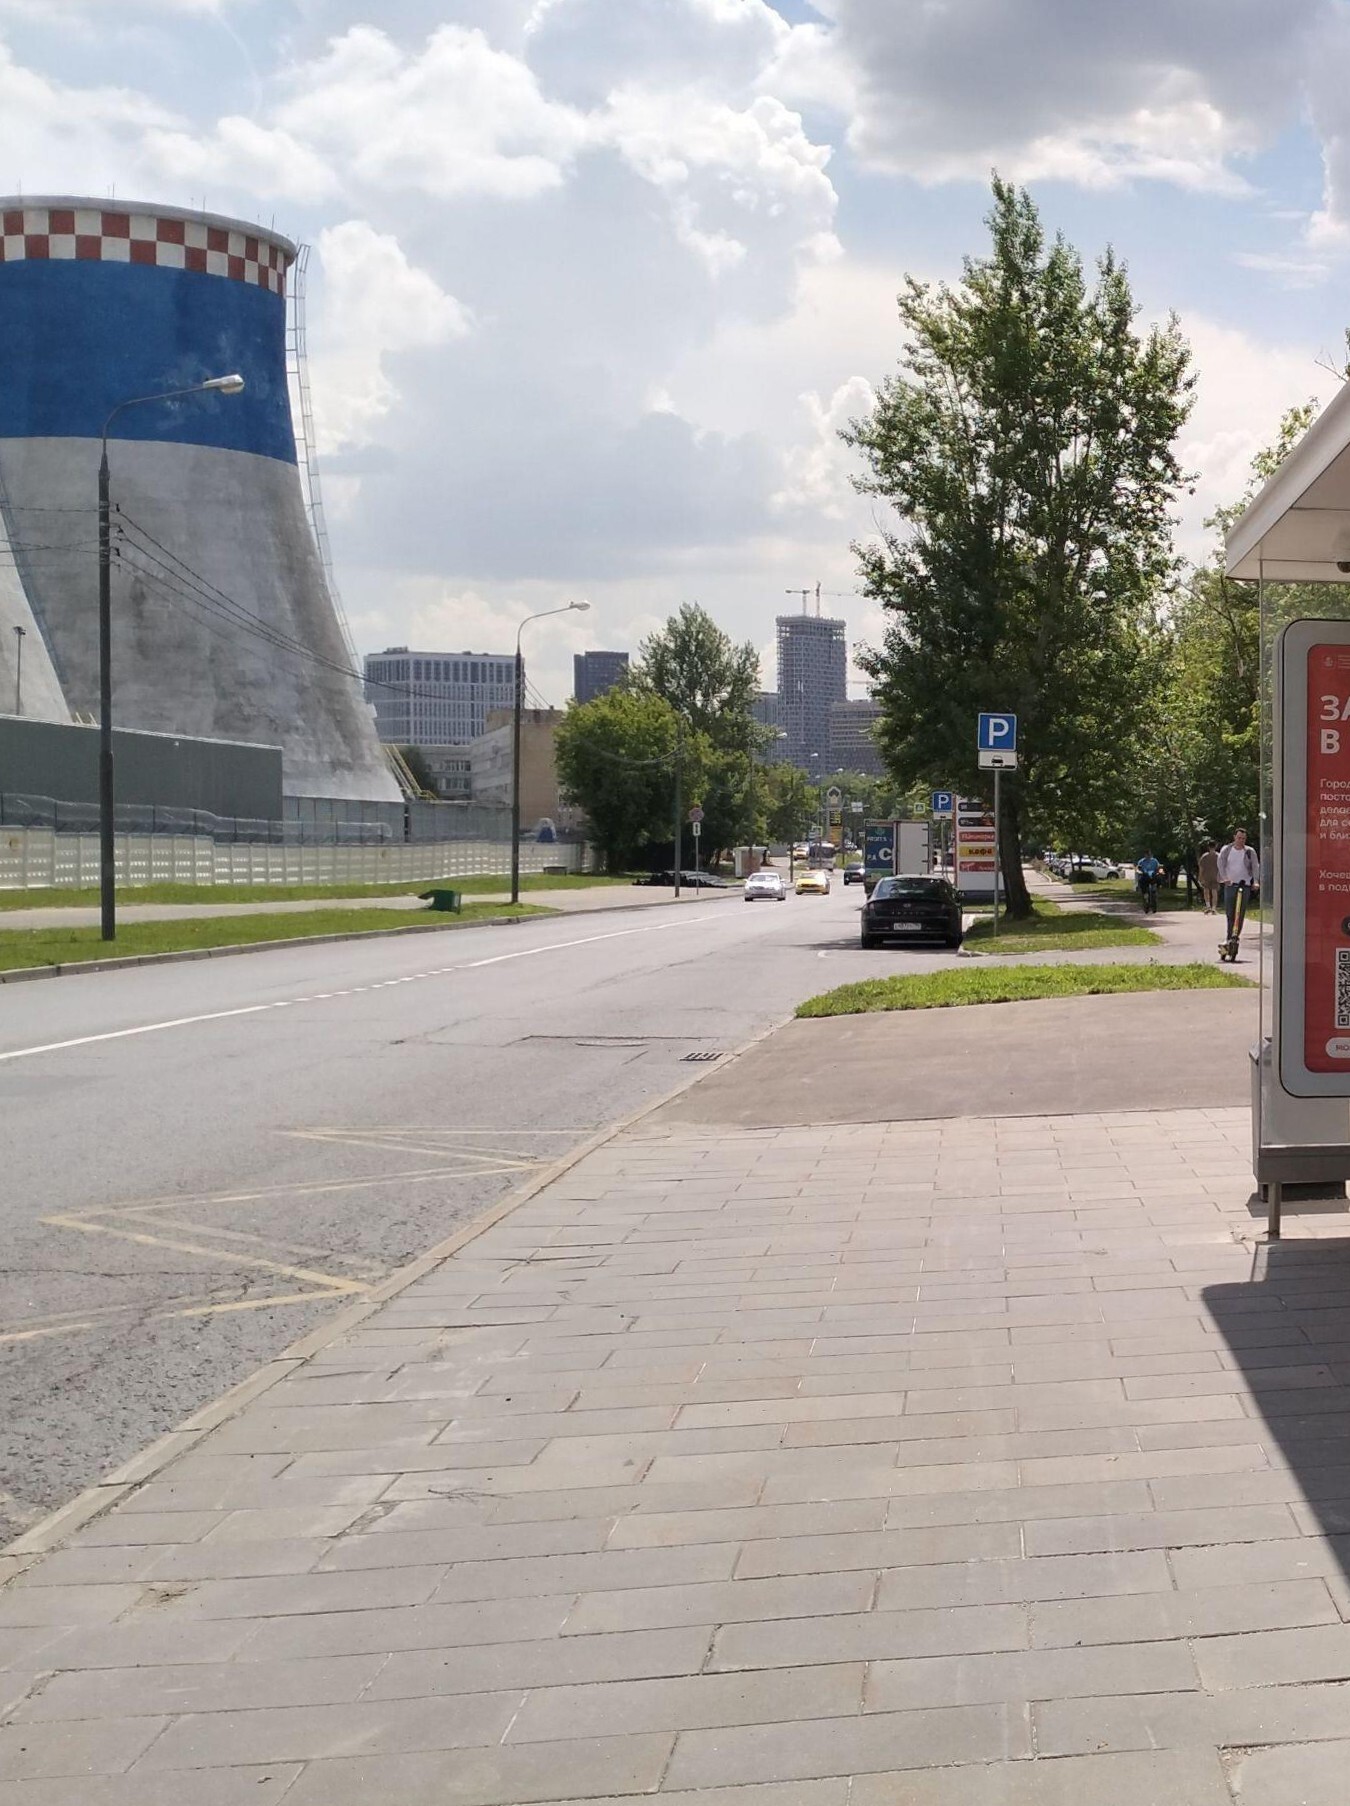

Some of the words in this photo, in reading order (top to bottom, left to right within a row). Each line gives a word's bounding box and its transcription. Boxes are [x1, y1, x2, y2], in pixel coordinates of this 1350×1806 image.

[989, 718, 1009, 745] P
[1320, 729, 1340, 754] В
[938, 795, 949, 808] P
[1319, 819, 1339, 828] для
